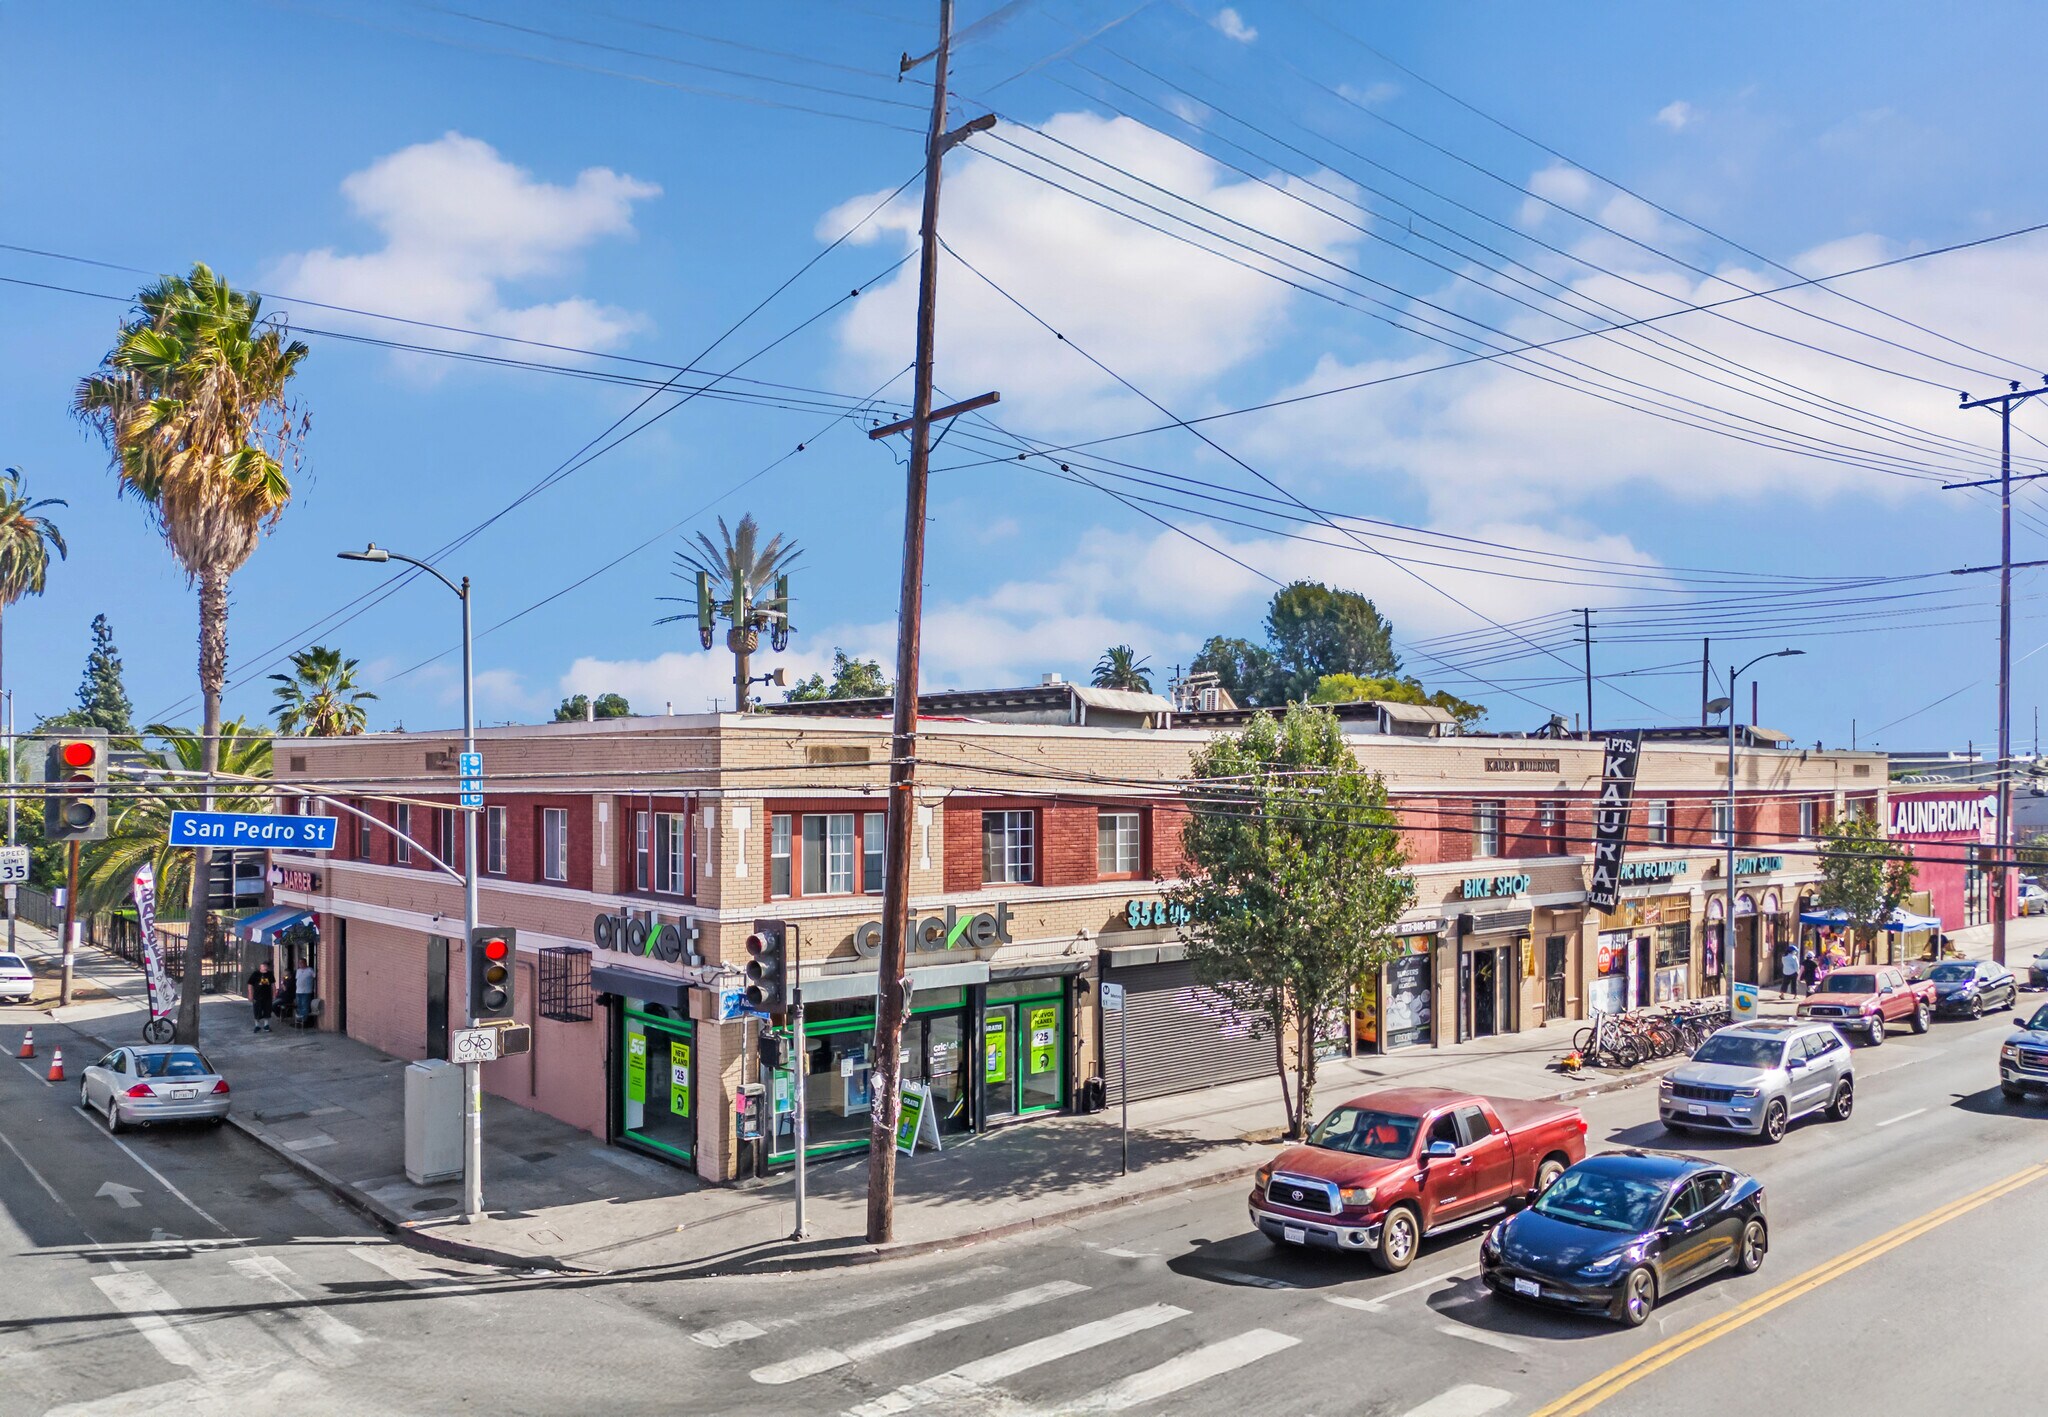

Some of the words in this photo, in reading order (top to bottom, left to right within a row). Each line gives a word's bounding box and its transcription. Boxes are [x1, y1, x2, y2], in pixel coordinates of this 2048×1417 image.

[1487, 760, 1516, 771] KAURA
[1519, 761, 1556, 771] BUILDING
[469, 756, 480, 802] SYNC
[1592, 755, 1626, 889] KAURA
[1887, 800, 1985, 835] LAUNDROMAT
[183, 819, 225, 837] San
[233, 821, 295, 839] Pedro
[303, 823, 326, 841] St
[3, 865, 26, 879] 35
[1643, 862, 1658, 879] GO
[1658, 860, 1689, 877] MARKET
[1734, 857, 1757, 875] EAUTY
[1758, 855, 1783, 872] SALON
[284, 870, 312, 891] BARBER
[1463, 879, 1492, 899] BIKE
[1496, 874, 1532, 896] SHOP
[1586, 890, 1615, 905] PLAZA
[1128, 900, 1151, 929] $5
[1153, 901, 1167, 925] &
[593, 906, 700, 967] cricket
[852, 901, 1015, 958] cicket
[630, 1038, 645, 1056] 5G
